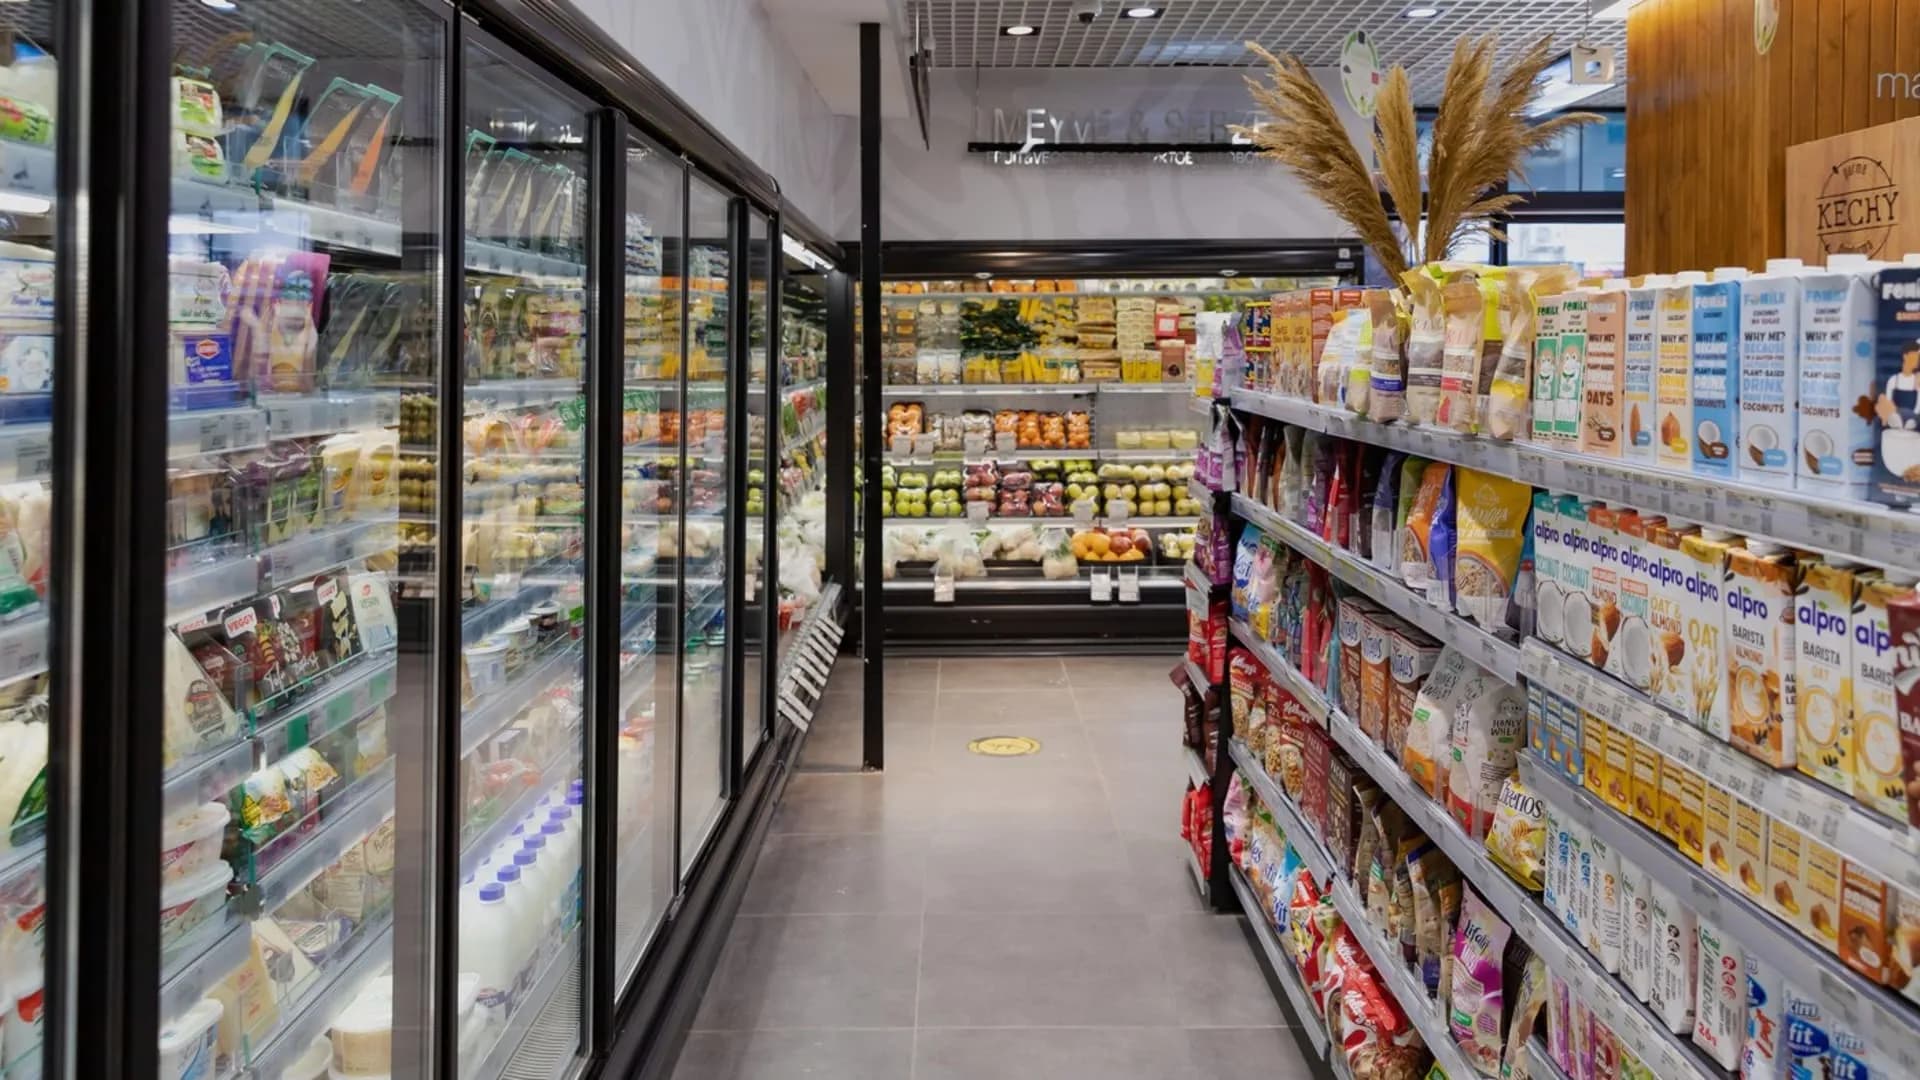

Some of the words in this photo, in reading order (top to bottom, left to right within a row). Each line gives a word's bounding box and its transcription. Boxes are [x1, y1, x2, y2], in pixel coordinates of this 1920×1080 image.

[1817, 192, 1899, 230] KECHY
[1744, 331, 1766, 341] WHY
[1768, 331, 1786, 341] ME?
[1806, 332, 1827, 341] WHY
[1587, 390, 1614, 406] OATS
[1743, 402, 1784, 413] COCONUTS
[1535, 520, 1559, 544] alpro
[1563, 528, 1589, 553] alpro
[1591, 536, 1618, 562] alpro
[1621, 545, 1648, 573] alpro
[1649, 558, 1683, 587] alpro
[1686, 571, 1719, 603] alpro
[1651, 597, 1670, 616] OAT
[1727, 586, 1768, 619] alpro
[226, 613, 256, 633] VEGGY
[1798, 600, 1846, 636] alpro
[1688, 618, 1719, 652] OAT
[1732, 624, 1765, 647] BARISTA
[1855, 619, 1891, 656] alp
[1803, 641, 1840, 666] BARISTA
[1861, 662, 1892, 686] BARIS
[1702, 951, 1715, 1026] PROTEIN
[1789, 1021, 1814, 1045] fit
[1833, 1056, 1857, 1080] fit
